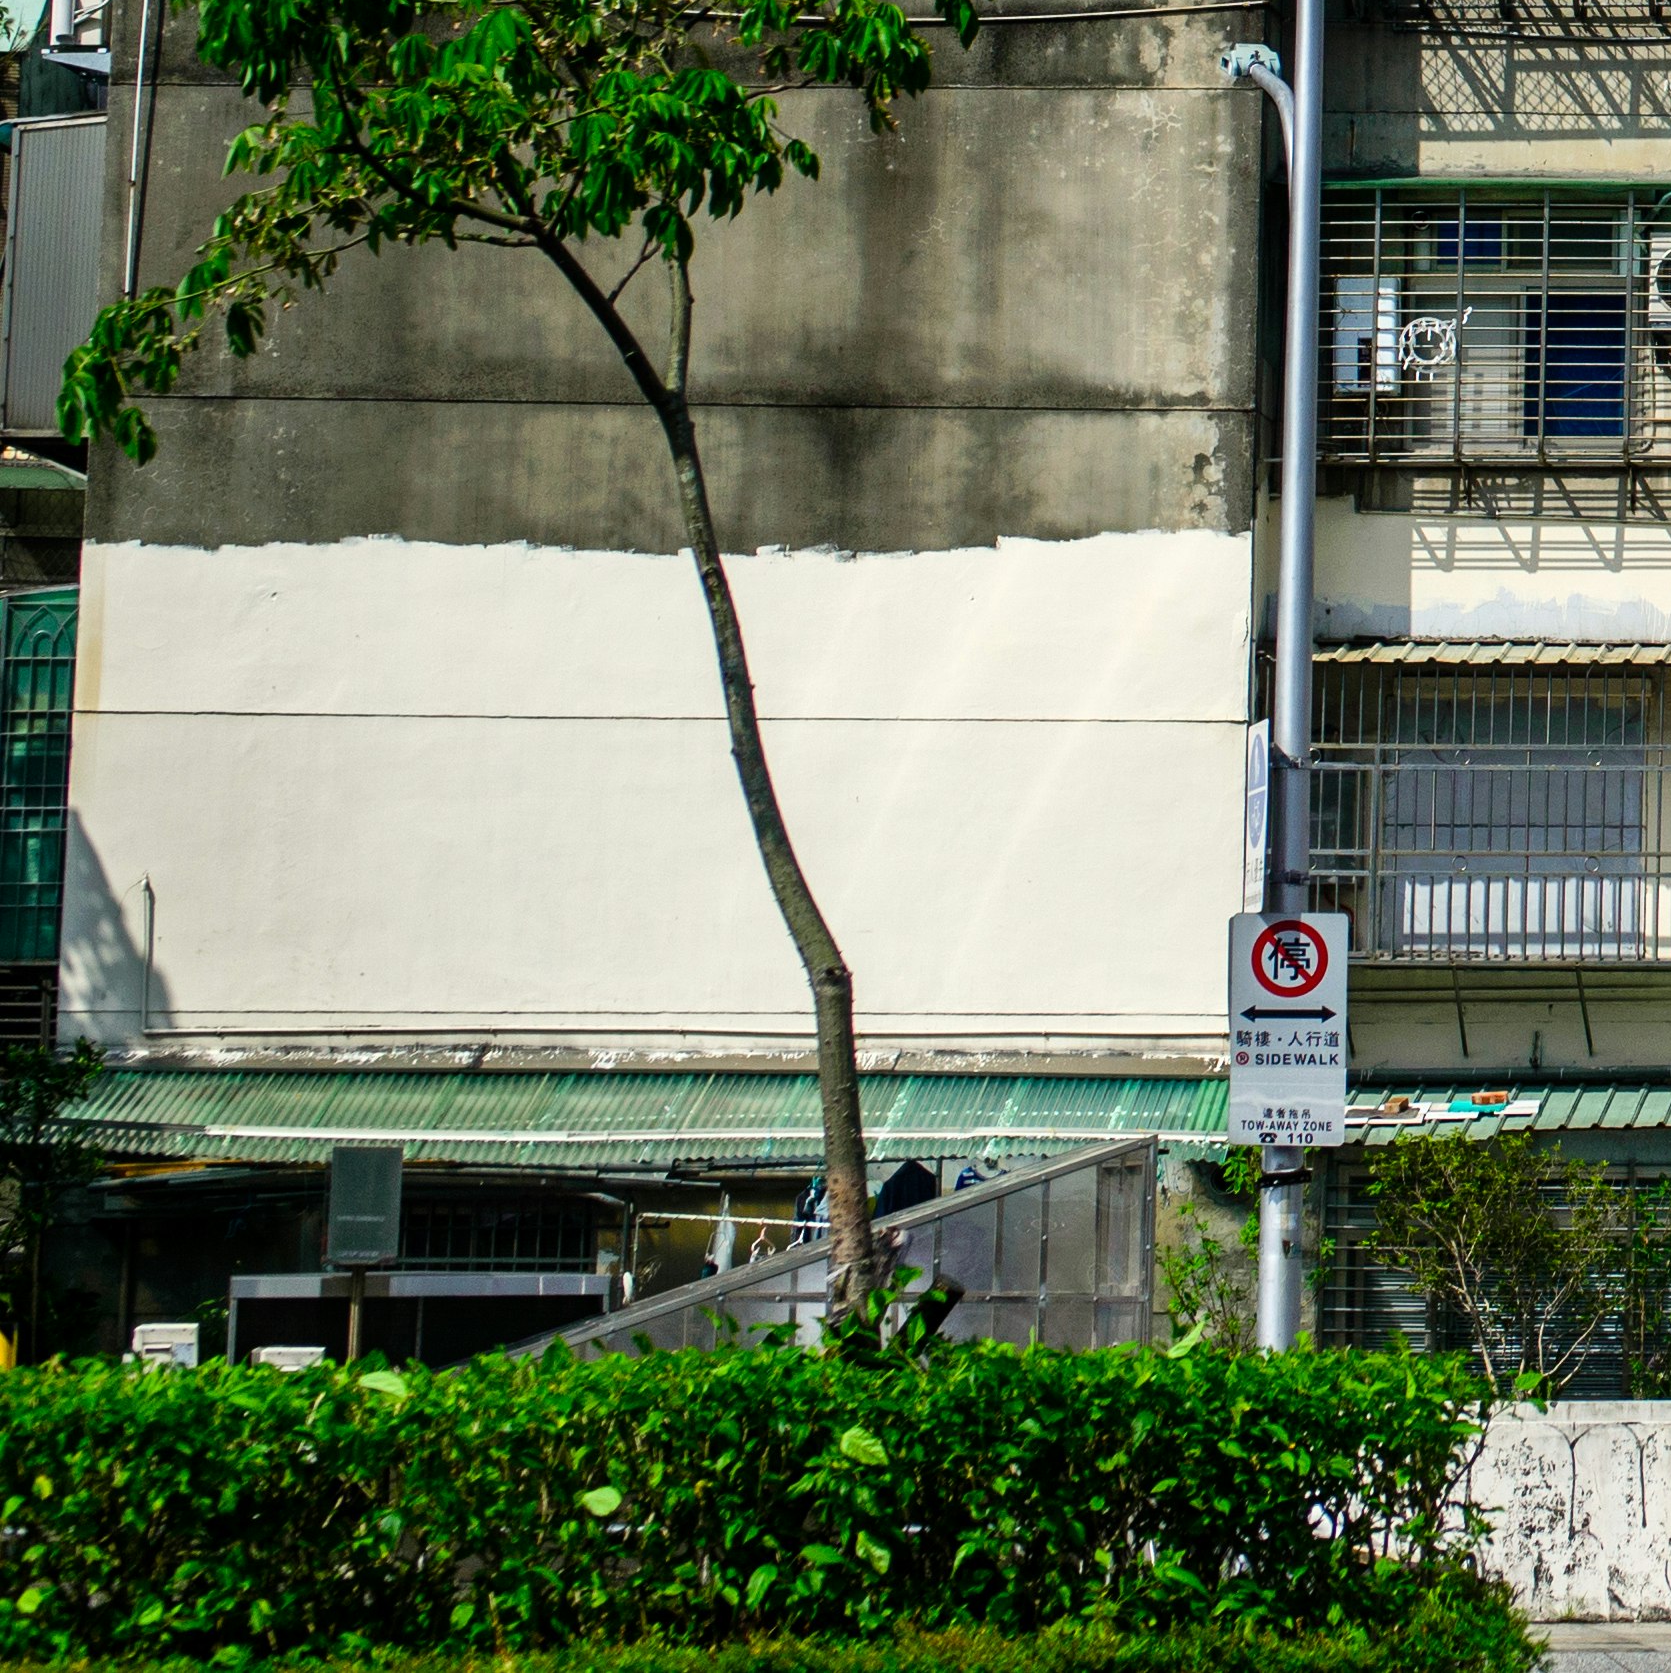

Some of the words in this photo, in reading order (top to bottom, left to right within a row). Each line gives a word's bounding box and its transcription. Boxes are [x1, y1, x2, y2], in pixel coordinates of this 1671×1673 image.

[1267, 937, 1311, 981] 停
[1255, 1053, 1339, 1066] SIDEWALK
[1241, 1119, 1299, 1132] TOW-AWAY
[1303, 1121, 1333, 1132] ZONE
[1287, 1132, 1314, 1144] 110
